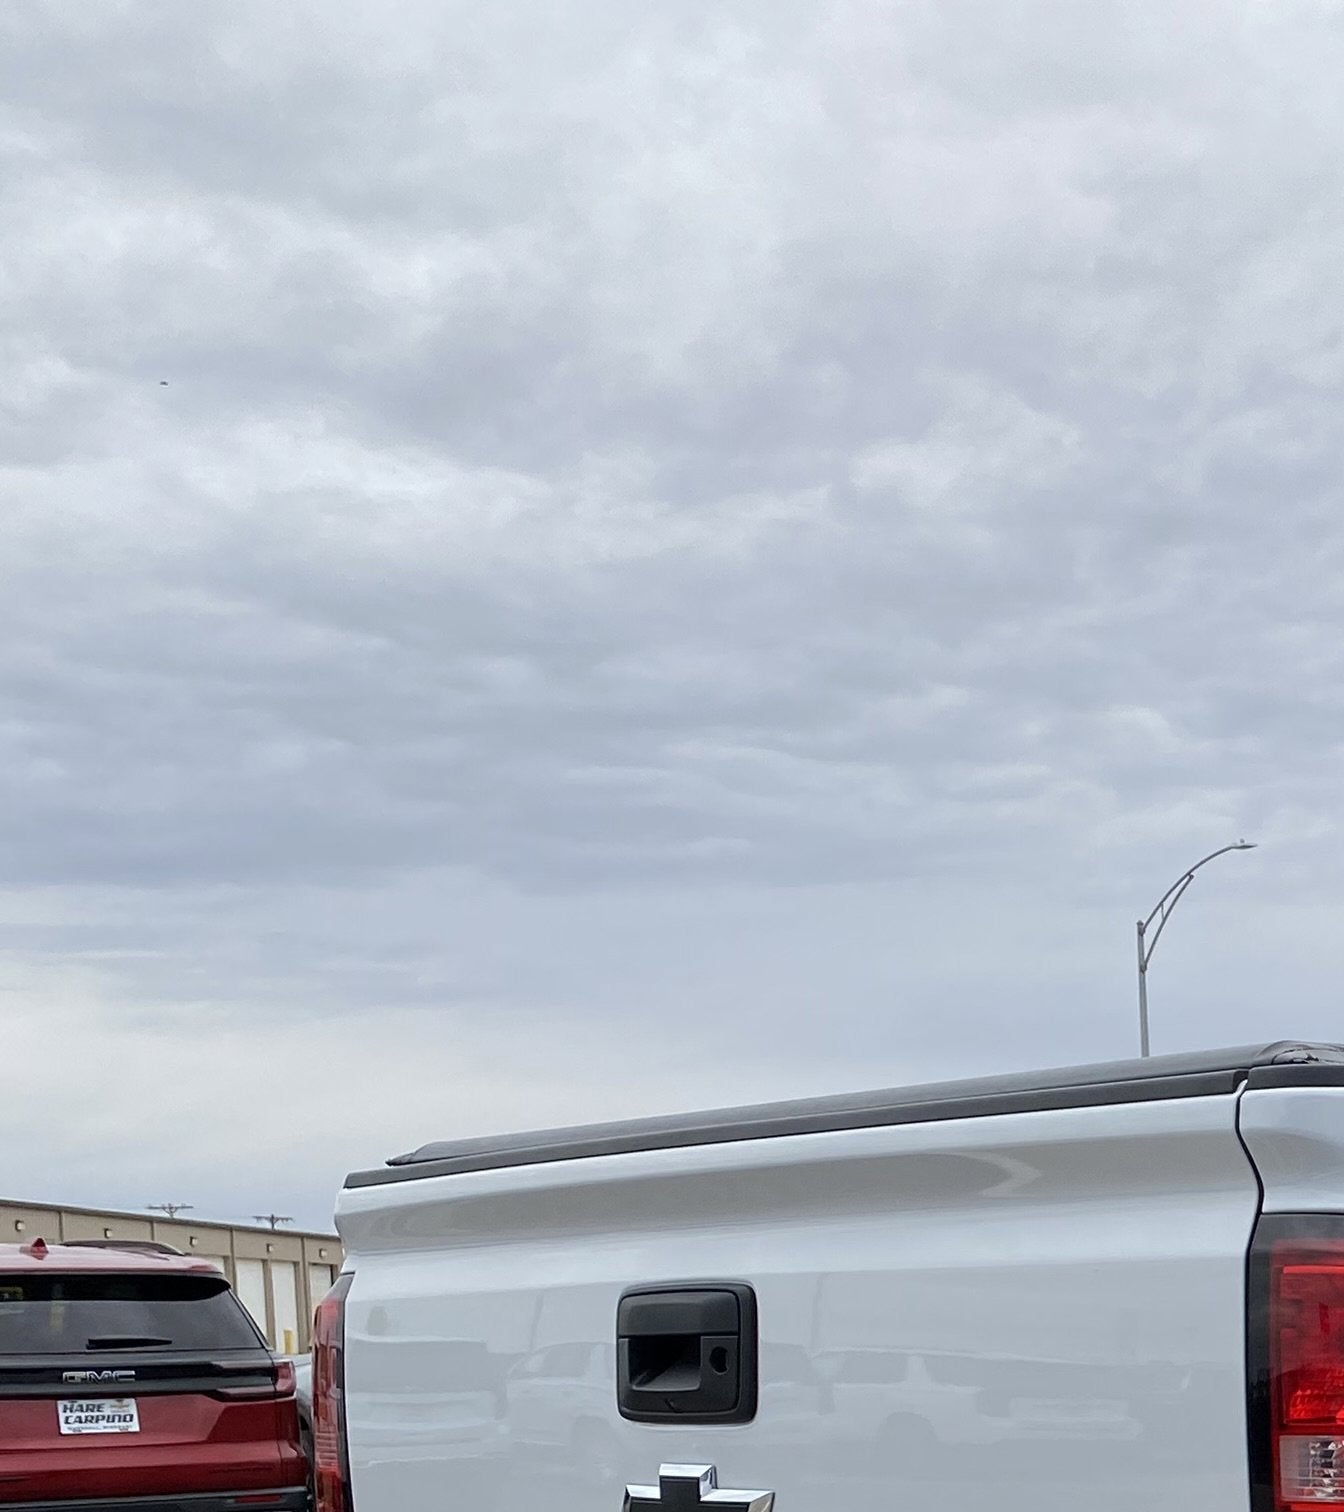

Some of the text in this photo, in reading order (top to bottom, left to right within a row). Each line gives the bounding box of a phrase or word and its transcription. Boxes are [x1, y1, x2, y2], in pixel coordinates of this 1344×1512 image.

[63, 1370, 135, 1384] GMC
[63, 1403, 105, 1413] HARE
[64, 1414, 134, 1424] CARPINO
